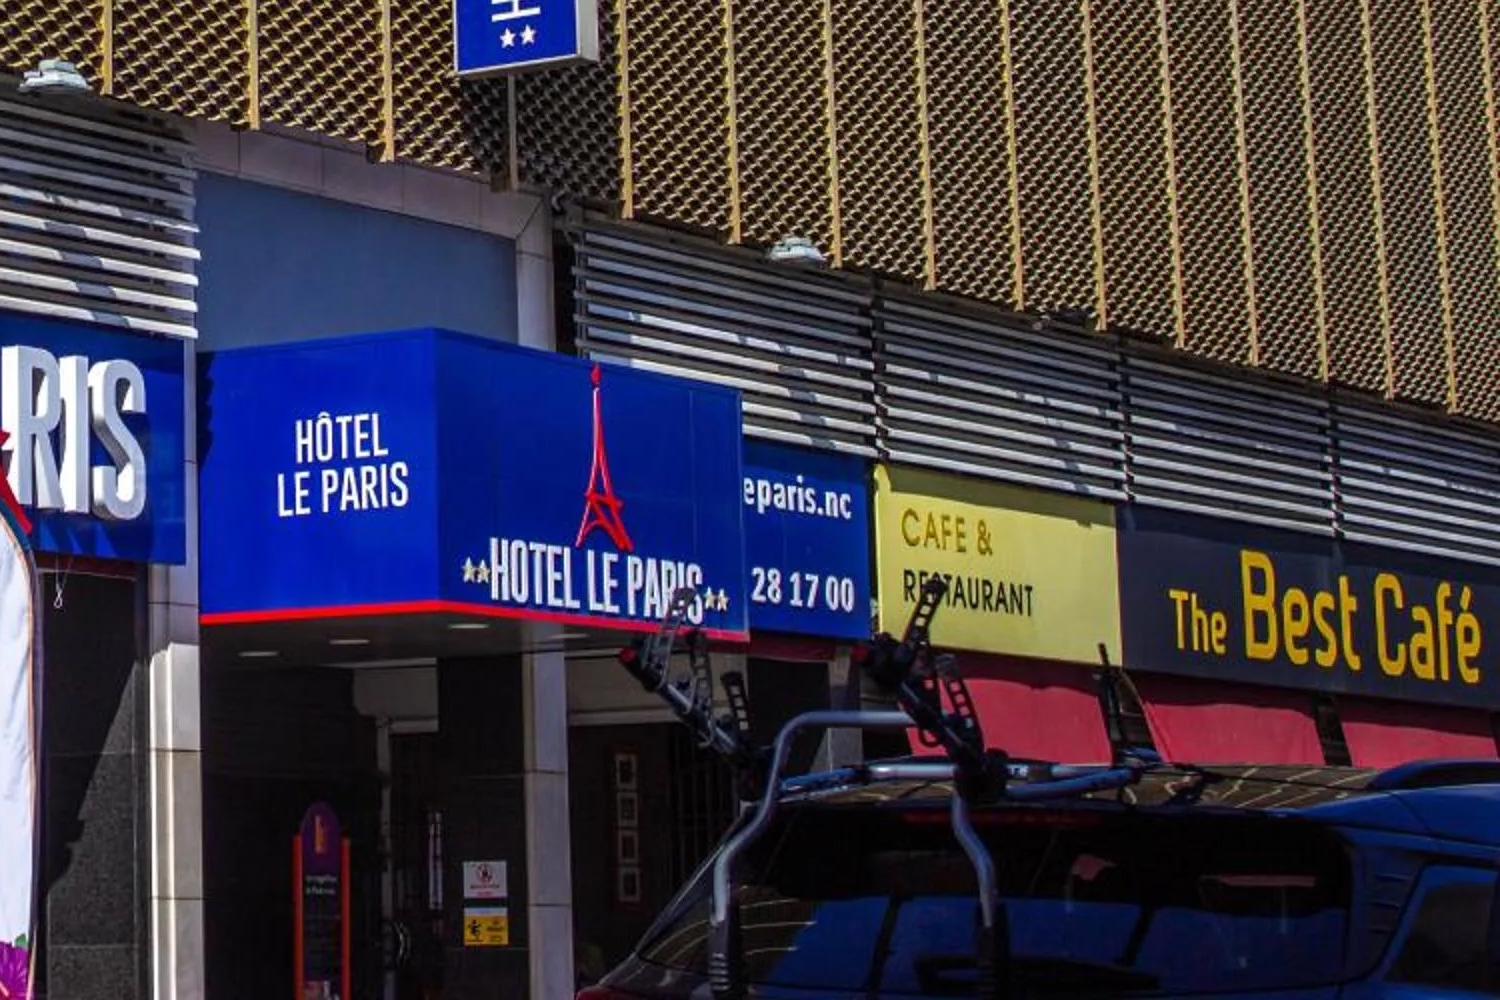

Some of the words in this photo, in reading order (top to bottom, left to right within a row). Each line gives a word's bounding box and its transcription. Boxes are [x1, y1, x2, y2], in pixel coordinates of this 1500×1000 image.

[295, 411, 389, 464] HÔTEL
[277, 471, 312, 518] LE
[321, 461, 409, 513] PARIS
[743, 475, 852, 520] eparis.nc
[901, 508, 967, 553] CAFE
[976, 519, 993, 556] &
[489, 537, 580, 610] HOTEL
[587, 548, 620, 614] LE
[752, 566, 782, 604] 28
[789, 571, 820, 609] 17
[825, 574, 855, 613] 00
[1168, 588, 1227, 654] The
[1240, 549, 1361, 670] Best
[1374, 573, 1481, 684] Café
